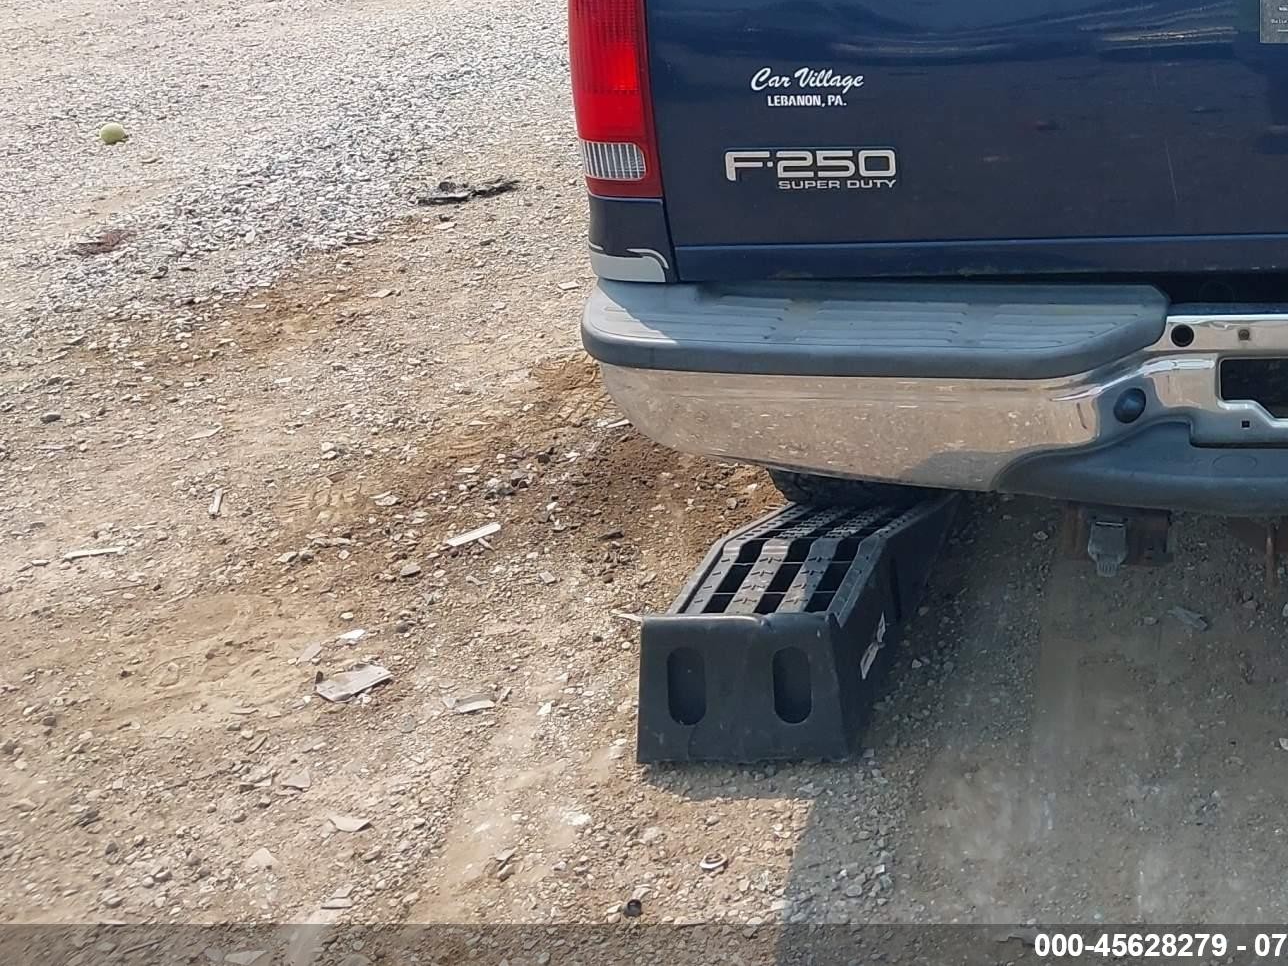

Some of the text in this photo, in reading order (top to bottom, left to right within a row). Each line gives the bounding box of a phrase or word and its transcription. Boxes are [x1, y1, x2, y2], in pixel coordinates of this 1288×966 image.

[751, 67, 864, 93] Car Village
[768, 95, 847, 107] LEBANON, PA.
[778, 179, 896, 189] SUPER DUTY
